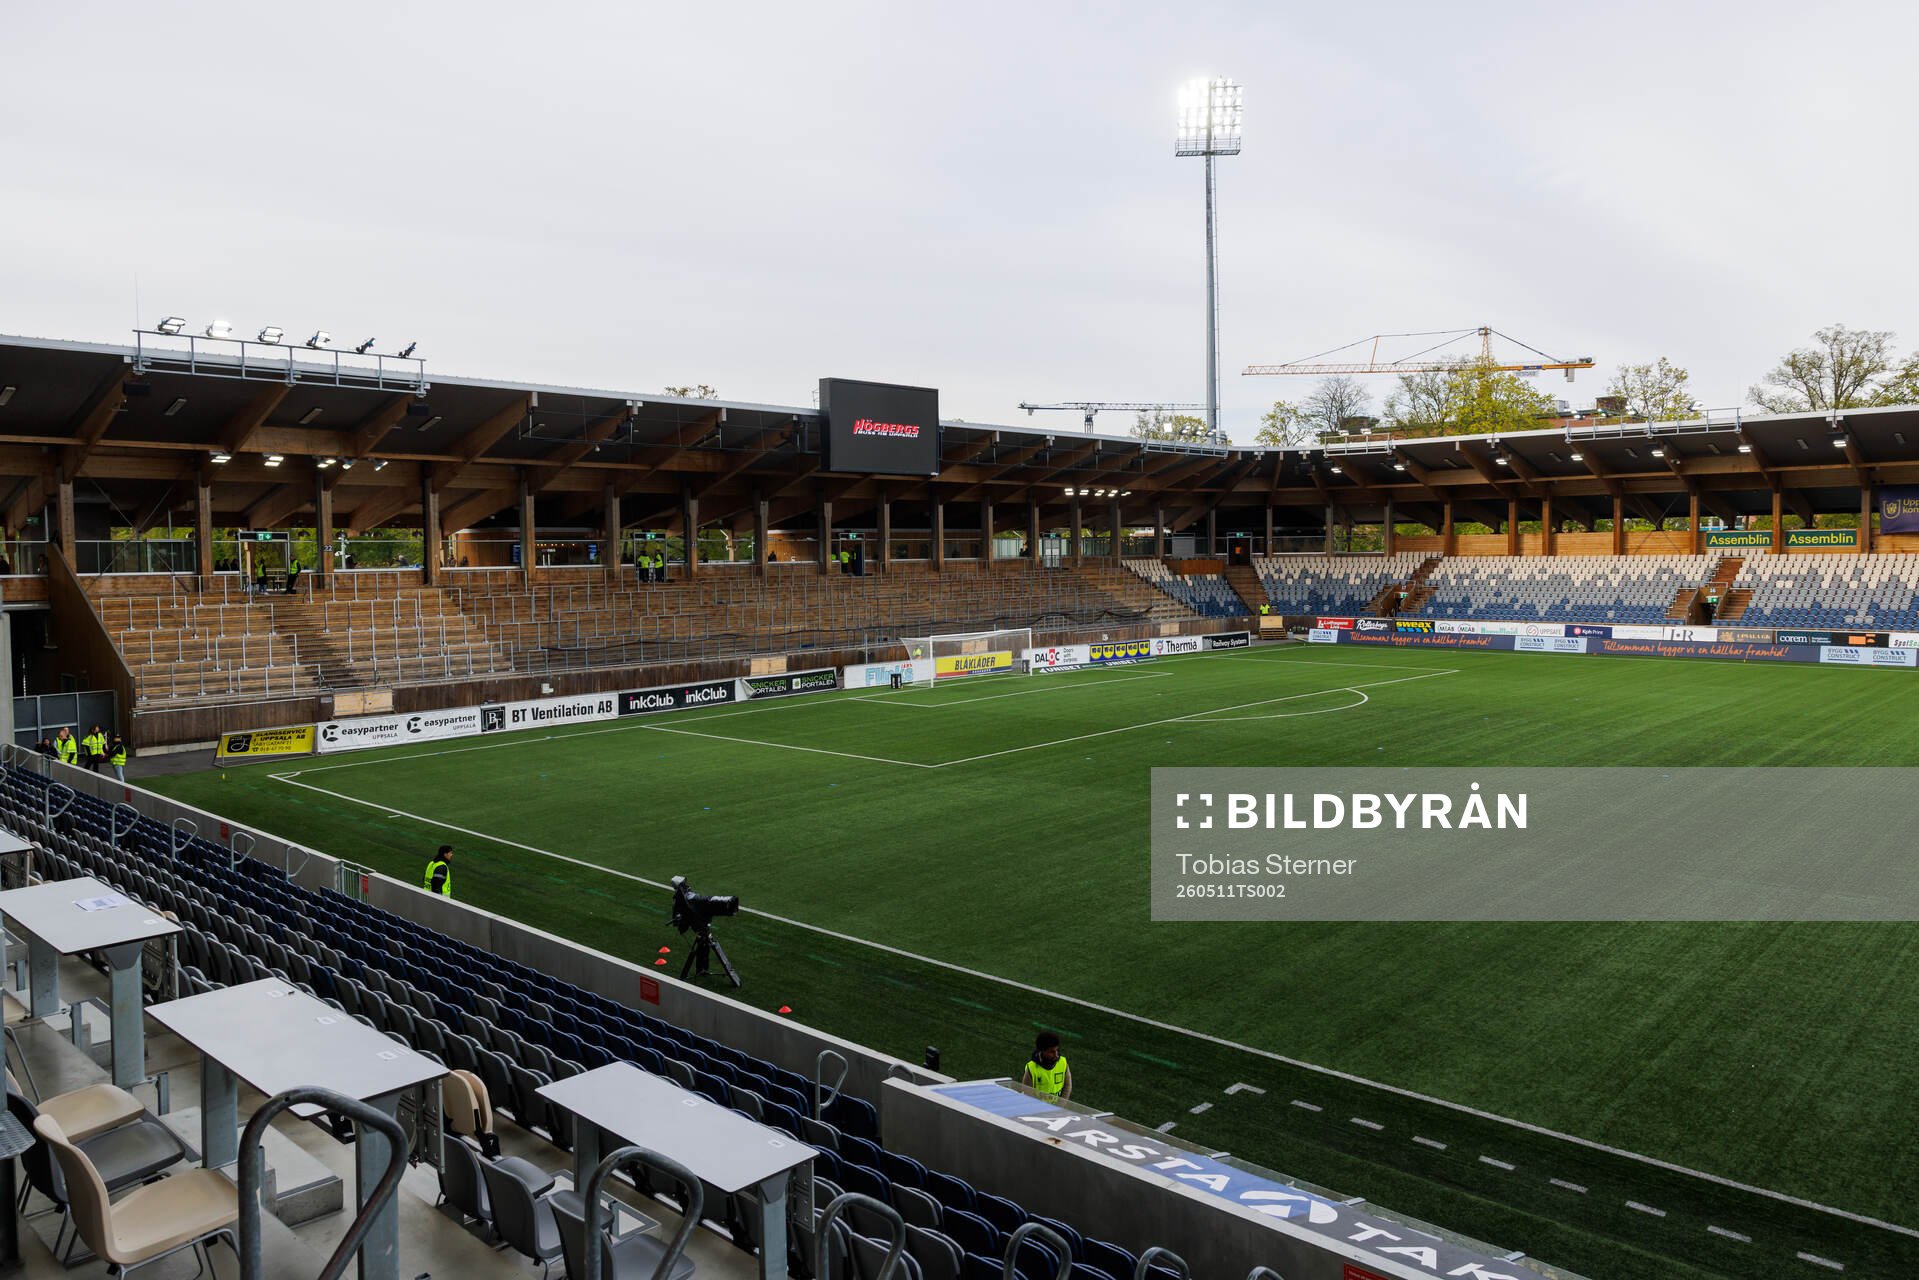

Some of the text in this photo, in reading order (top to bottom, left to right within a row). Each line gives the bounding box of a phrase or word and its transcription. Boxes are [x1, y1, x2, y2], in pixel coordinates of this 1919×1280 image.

[853, 418, 920, 435] HÖGBERGS
[1709, 534, 1771, 546] Assemblin
[1788, 533, 1854, 545] Assemblin
[1350, 632, 1390, 642] Tillsammans
[1779, 635, 1808, 643] corem
[1166, 639, 1198, 653] Thermia
[1602, 640, 1655, 652] Tillsammans
[1656, 641, 1685, 656] bygger
[1686, 644, 1695, 653] vi
[1710, 643, 1743, 655] hållbar
[1745, 644, 1789, 659] framtid!
[1035, 651, 1060, 663] DALOC
[755, 684, 787, 694] ORTALEN
[801, 679, 835, 689] PORTALEN
[685, 686, 727, 703] inkClub
[629, 693, 674, 710] inkClub
[512, 700, 613, 723] BT Ventilation AB
[424, 714, 477, 727] easypartner
[341, 724, 399, 736] easypartner
[452, 723, 477, 731] UPPSALA
[372, 732, 399, 740] UPPSALA
[1018, 1114, 1231, 1192] ÅRSTA
